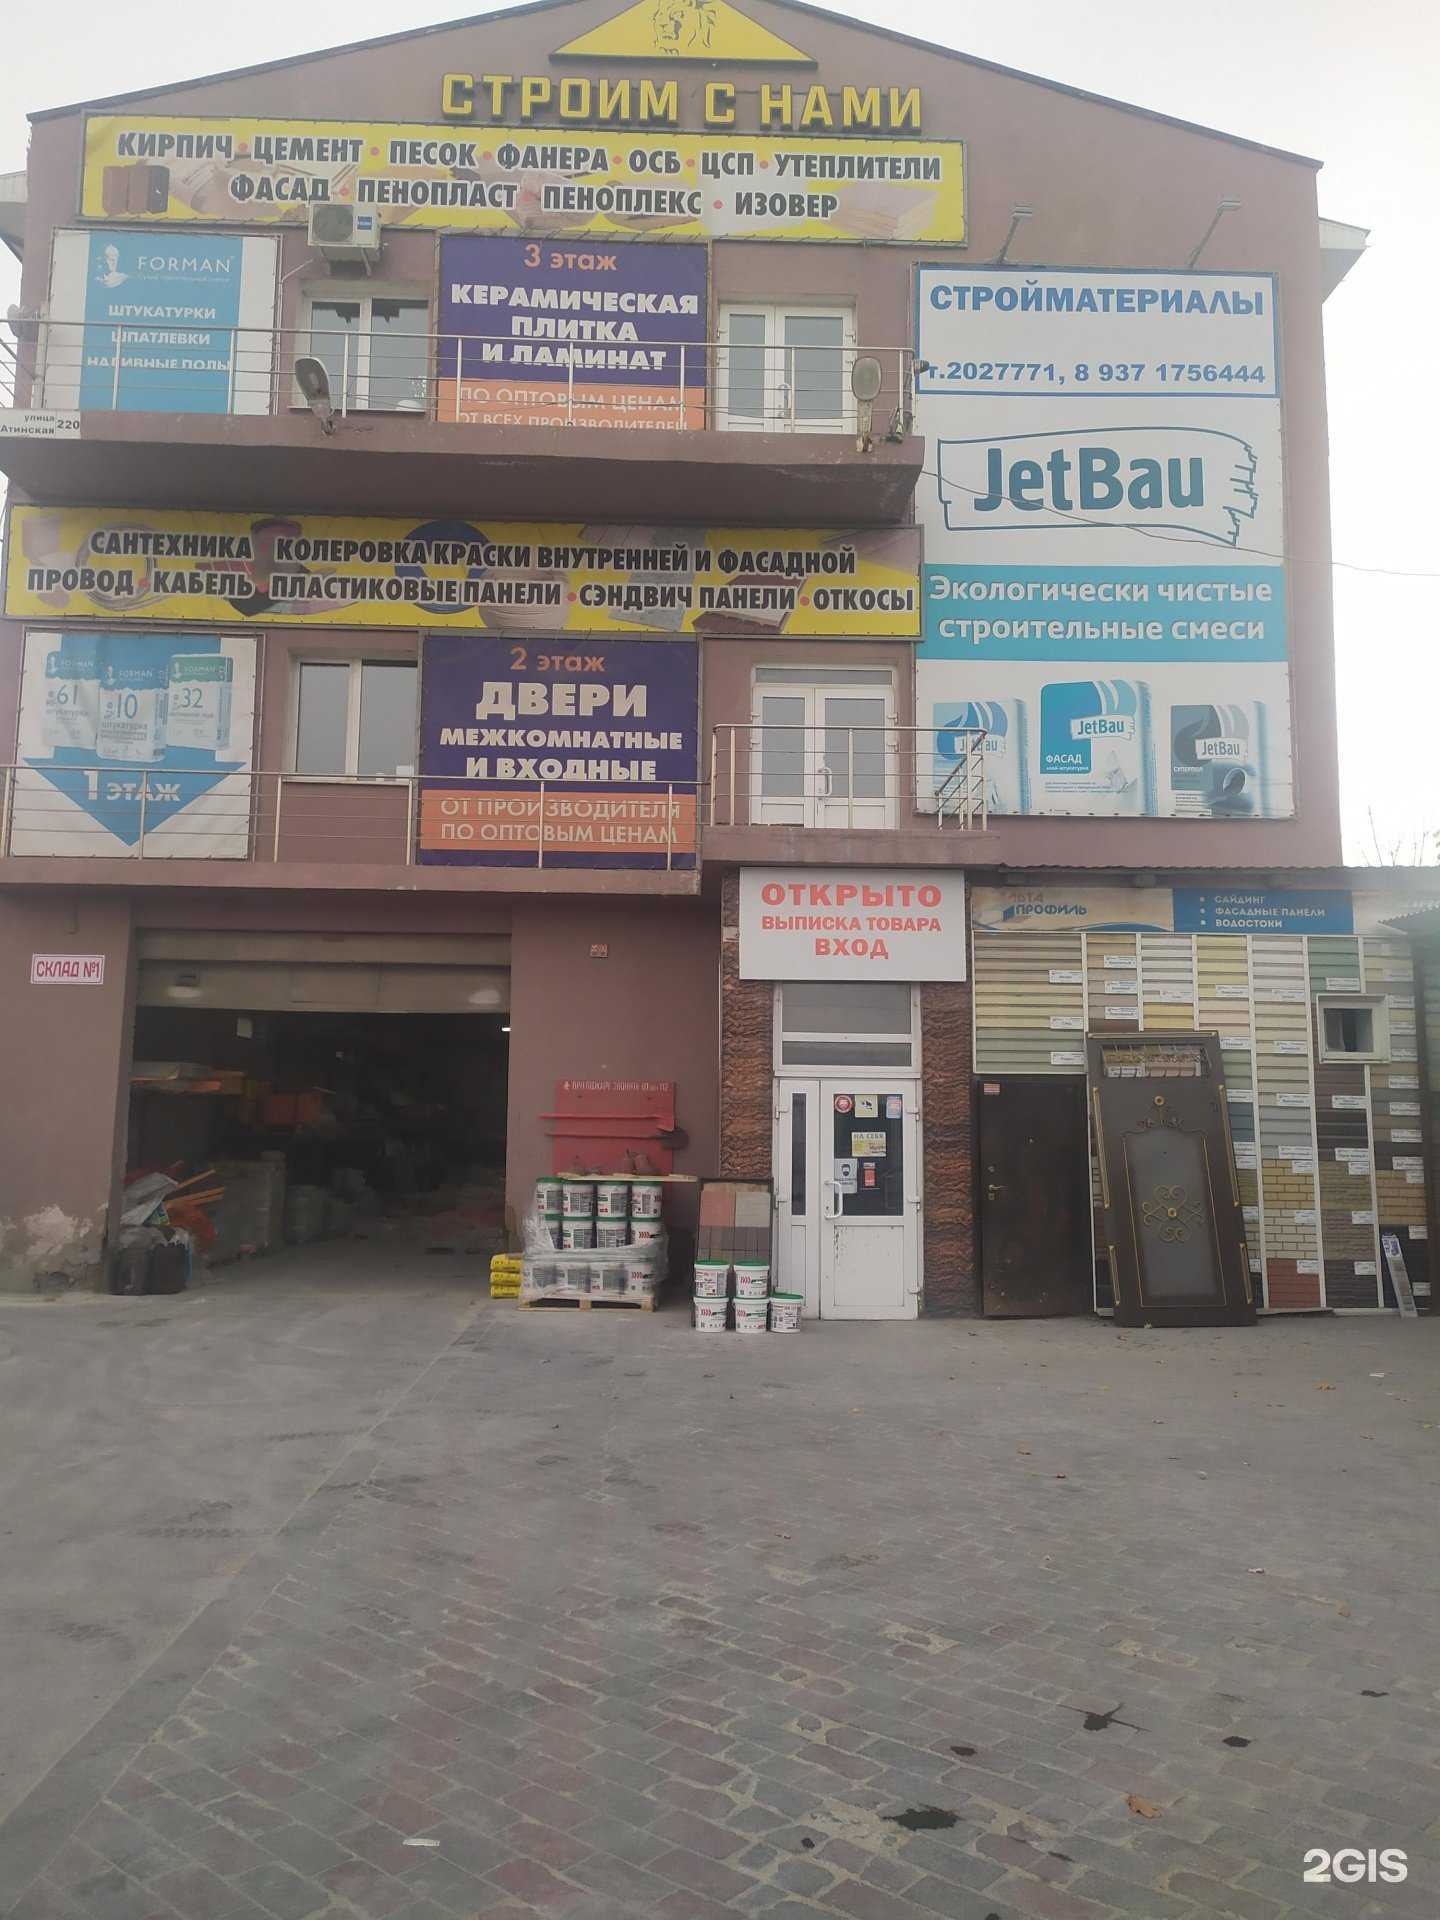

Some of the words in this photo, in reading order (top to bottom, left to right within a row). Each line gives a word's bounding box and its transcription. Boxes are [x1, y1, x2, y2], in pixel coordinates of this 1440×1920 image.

[442, 73, 679, 122] СТРОИМ
[705, 82, 735, 124] С
[761, 84, 921, 128] НАМИ
[118, 132, 232, 158] КИРПИЧ
[254, 137, 363, 165] ЦЕМЕНТ
[389, 141, 475, 166] ПЕСОК
[497, 144, 608, 171] ФАНЕРА
[629, 149, 680, 174] ОСБ
[702, 153, 754, 179] ЦСП
[774, 154, 941, 180] УТЕПЛИТЕЛИ
[231, 176, 330, 202] ФАСАД
[358, 179, 517, 208] ПЕНОПЛАСТ
[543, 186, 702, 215] ПЕНОПЛЕКС
[735, 192, 837, 219] ИЗОВЕР
[138, 256, 230, 272] FORMAN
[524, 244, 541, 268] 3
[551, 253, 617, 271] этаж
[451, 284, 698, 314] КЕРАМИЧЕСКАЯ
[930, 279, 1263, 315] СТРОЙМАТЕРИАЛЫ
[108, 305, 216, 319] ШТУКАТУРКИ
[111, 331, 210, 345] ШПАТЛЕВКИ
[512, 316, 639, 341] ПЛИТКА
[482, 344, 503, 362] И
[510, 346, 667, 370] ЛАМИНАТ
[1074, 364, 1089, 382] 8
[1099, 364, 1145, 382] 937
[1156, 364, 1265, 383] 1756444
[460, 387, 490, 403] ПО
[496, 389, 605, 409] ОПТОВЫМ
[57, 419, 80, 430] 220
[974, 447, 1204, 512] JetBau
[91, 532, 252, 559] САНТЕХНИКА
[277, 538, 426, 564] КОЛЕРОВКА
[434, 542, 531, 567] КРАСКИ
[538, 543, 688, 571] ВНУТРЕННЕЙ
[695, 550, 711, 572] И
[718, 546, 855, 577] ФАСАДНОЙ
[28, 568, 134, 595] ПРОВОД
[154, 571, 253, 597] КАБЕЛЬ
[271, 575, 456, 602] ПЛАСТИКОВЫЕ
[464, 579, 561, 606] ПАНЕЛИ
[579, 584, 692, 611] СЭНДВИЧ
[700, 586, 795, 611] ПАНЕЛИ
[813, 588, 913, 611] ОТКОСЫ
[929, 575, 1150, 602] Экологически
[1158, 582, 1272, 602] чистые
[939, 618, 1163, 644] строительные
[1171, 620, 1265, 640] смеси
[510, 647, 527, 670] 2
[537, 655, 605, 672] этаж
[57, 685, 77, 704] 61
[117, 693, 138, 718] 10
[181, 688, 203, 708] 32
[476, 681, 647, 720] ДВЕРИ
[1077, 718, 1125, 735] JetBau
[440, 728, 682, 749] МЕЖКОМНАТНЫЕ
[1202, 741, 1240, 755] JetBau
[467, 758, 487, 778] И
[497, 758, 656, 780] ВХОДНЫЕ
[1046, 754, 1082, 764] ФАСАД
[83, 771, 98, 800] 1
[441, 798, 470, 815] ОТ
[441, 824, 473, 840] ПО
[481, 824, 593, 842] ОПТОВЫМ
[601, 826, 677, 845] ЦЕНАМ
[761, 883, 942, 908] ОТКРЫТО
[1016, 904, 1087, 915] ПРОФИЛЬ
[1215, 908, 1279, 917] ФАСАДНЫЕ
[1281, 908, 1325, 917] ПАНЕЛИ
[762, 916, 861, 932] ВЫПИСКА
[867, 917, 942, 932] ТОВАРА
[1215, 919, 1282, 928] ВОДОСТОКИ
[815, 938, 889, 960] ВХОД
[36, 961, 79, 977] СКЛАД
[83, 961, 100, 978] №1
